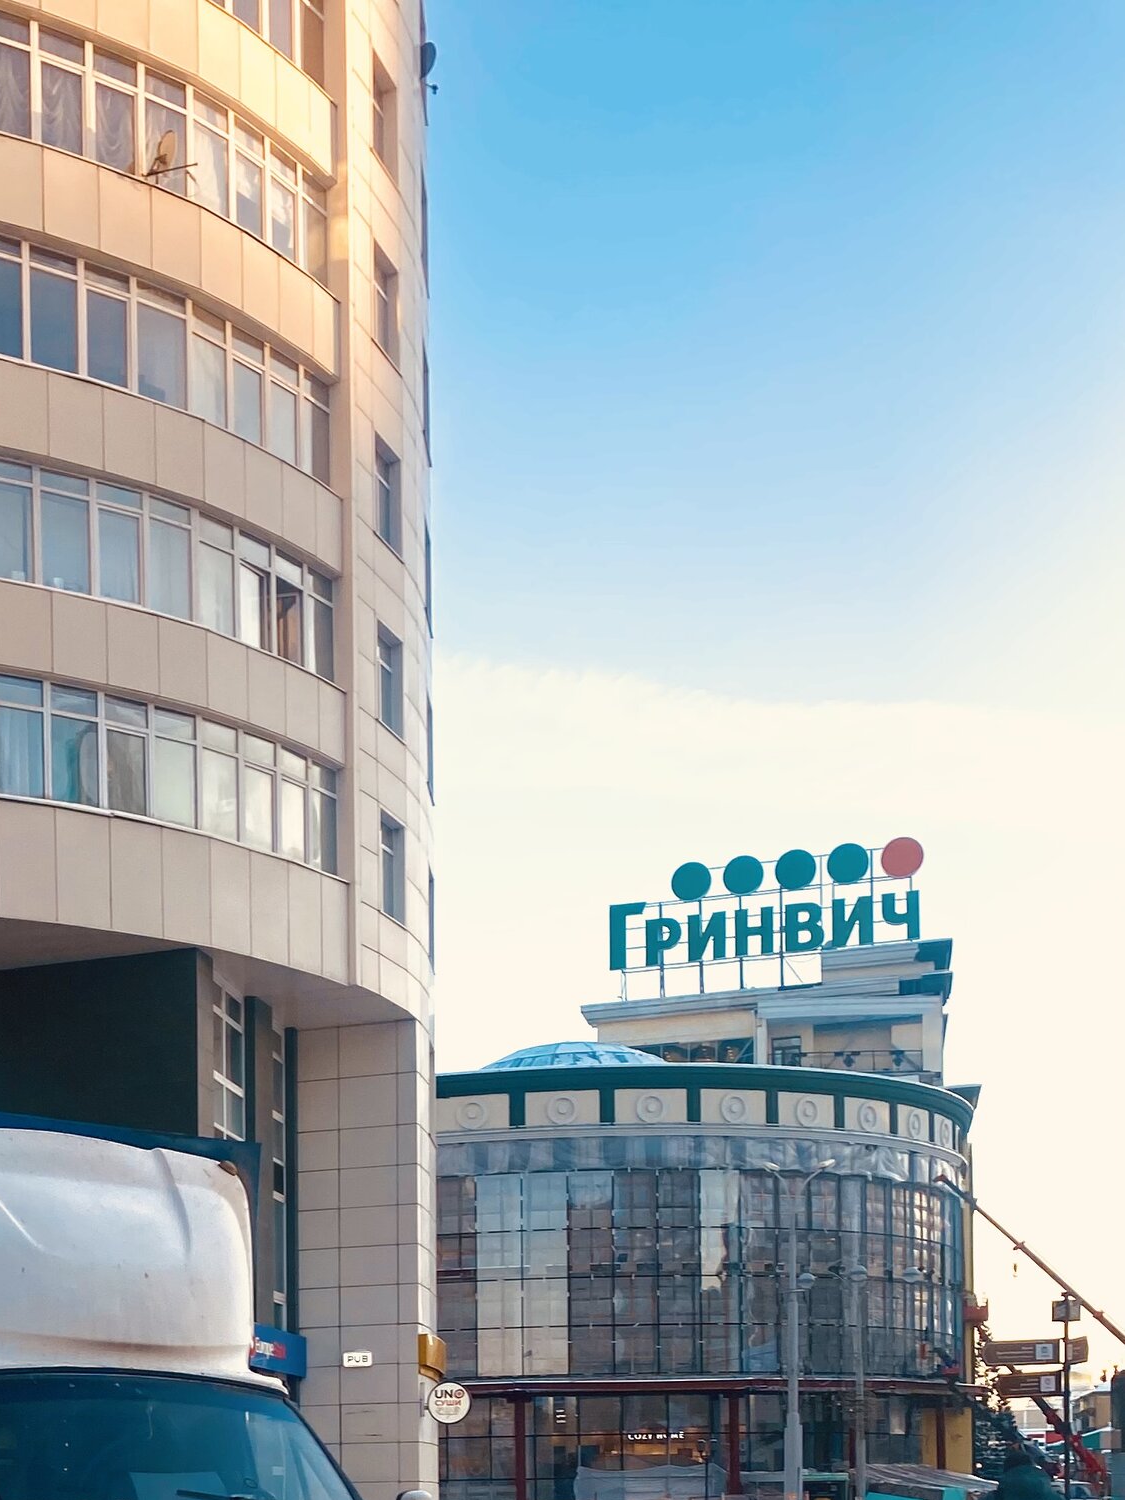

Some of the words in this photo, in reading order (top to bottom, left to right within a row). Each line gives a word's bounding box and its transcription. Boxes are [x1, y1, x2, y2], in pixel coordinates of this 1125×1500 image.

[347, 1355, 369, 1363] PUB
[435, 1389, 465, 1399] UNO
[434, 1399, 462, 1407] СУШИ
